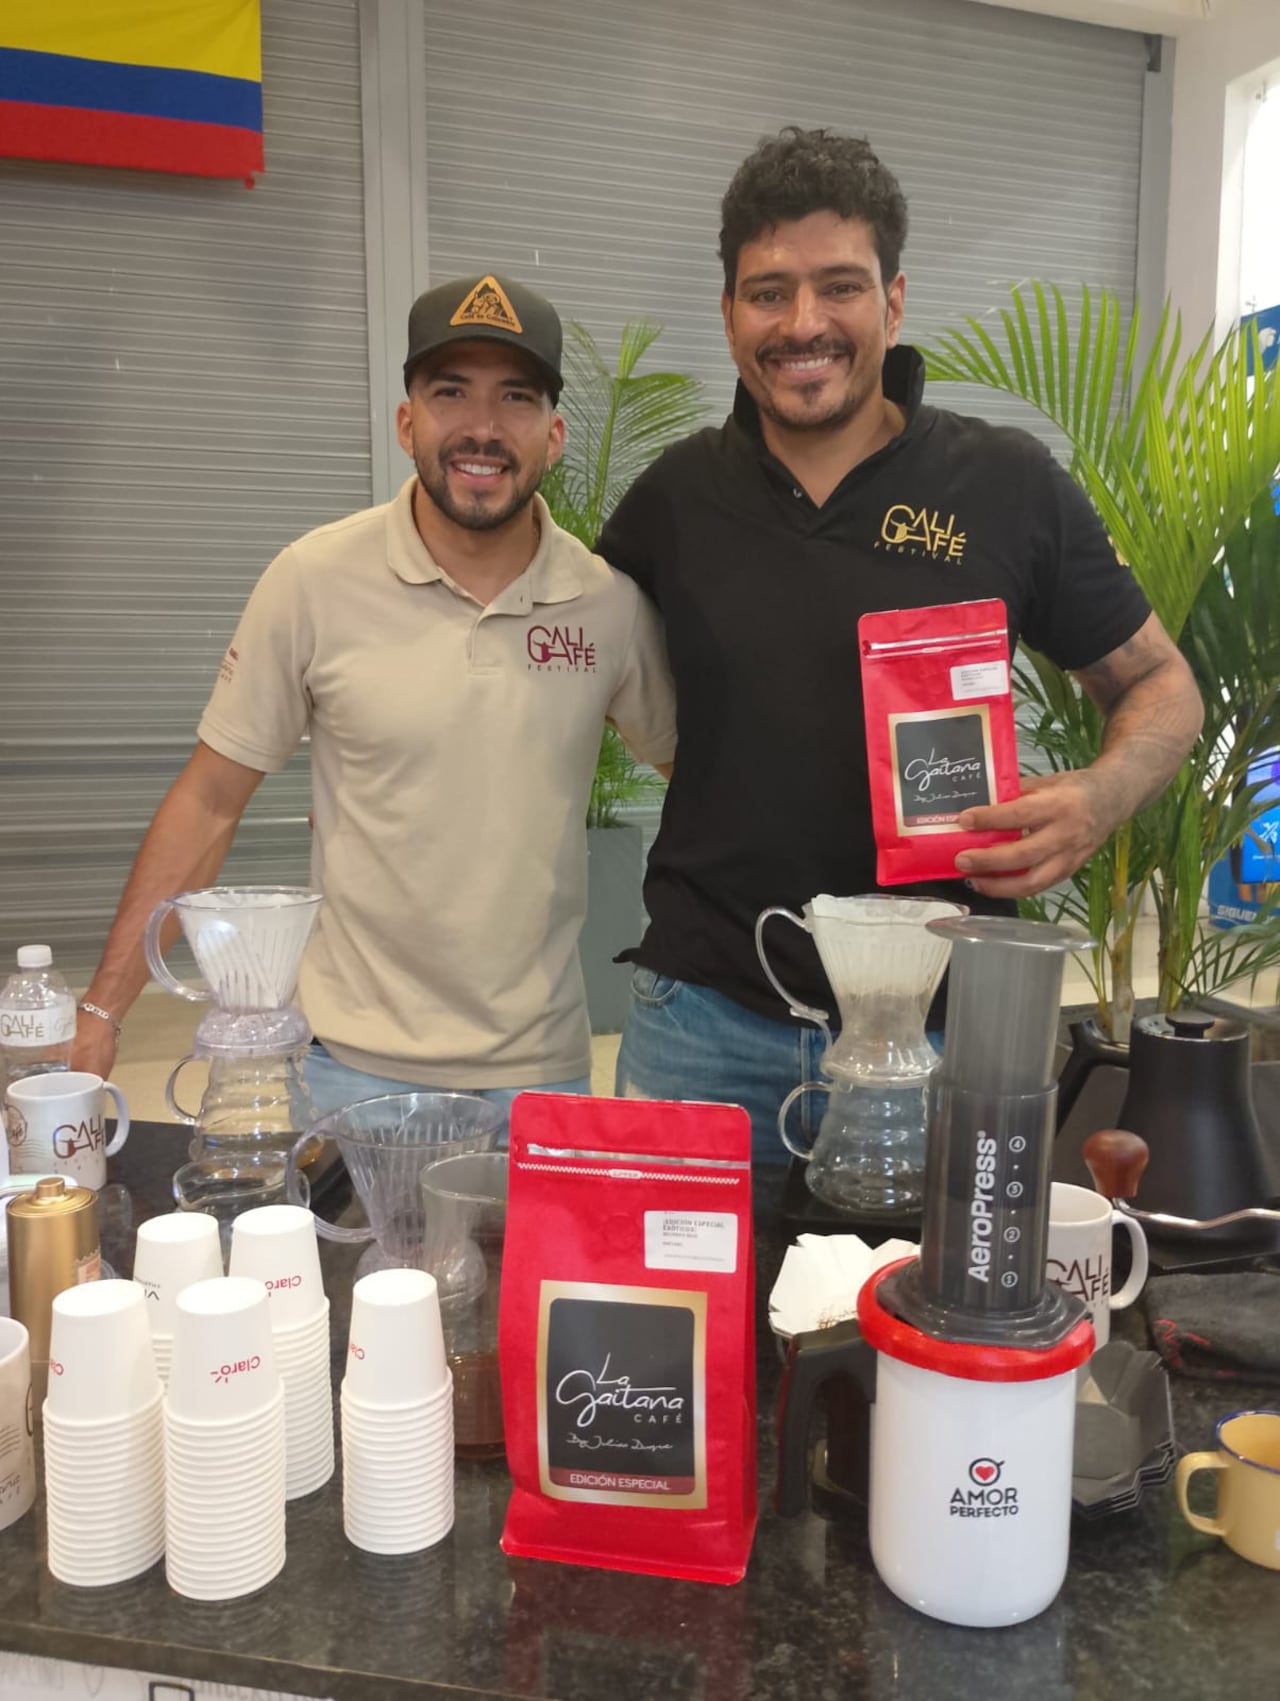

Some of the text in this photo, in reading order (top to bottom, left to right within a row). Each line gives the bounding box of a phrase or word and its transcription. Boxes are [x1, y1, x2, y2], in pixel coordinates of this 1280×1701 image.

[967, 1137, 998, 1283] AeroPress
[220, 1355, 261, 1376] Claro
[596, 1351, 630, 1385] La
[556, 1369, 684, 1428] Gaitana
[633, 1412, 683, 1424] CAFÉ
[570, 1473, 671, 1491] EDICIÓN ESPECIAL
[949, 1487, 1018, 1506] AMOR
[949, 1505, 1019, 1518] PERFECTO
